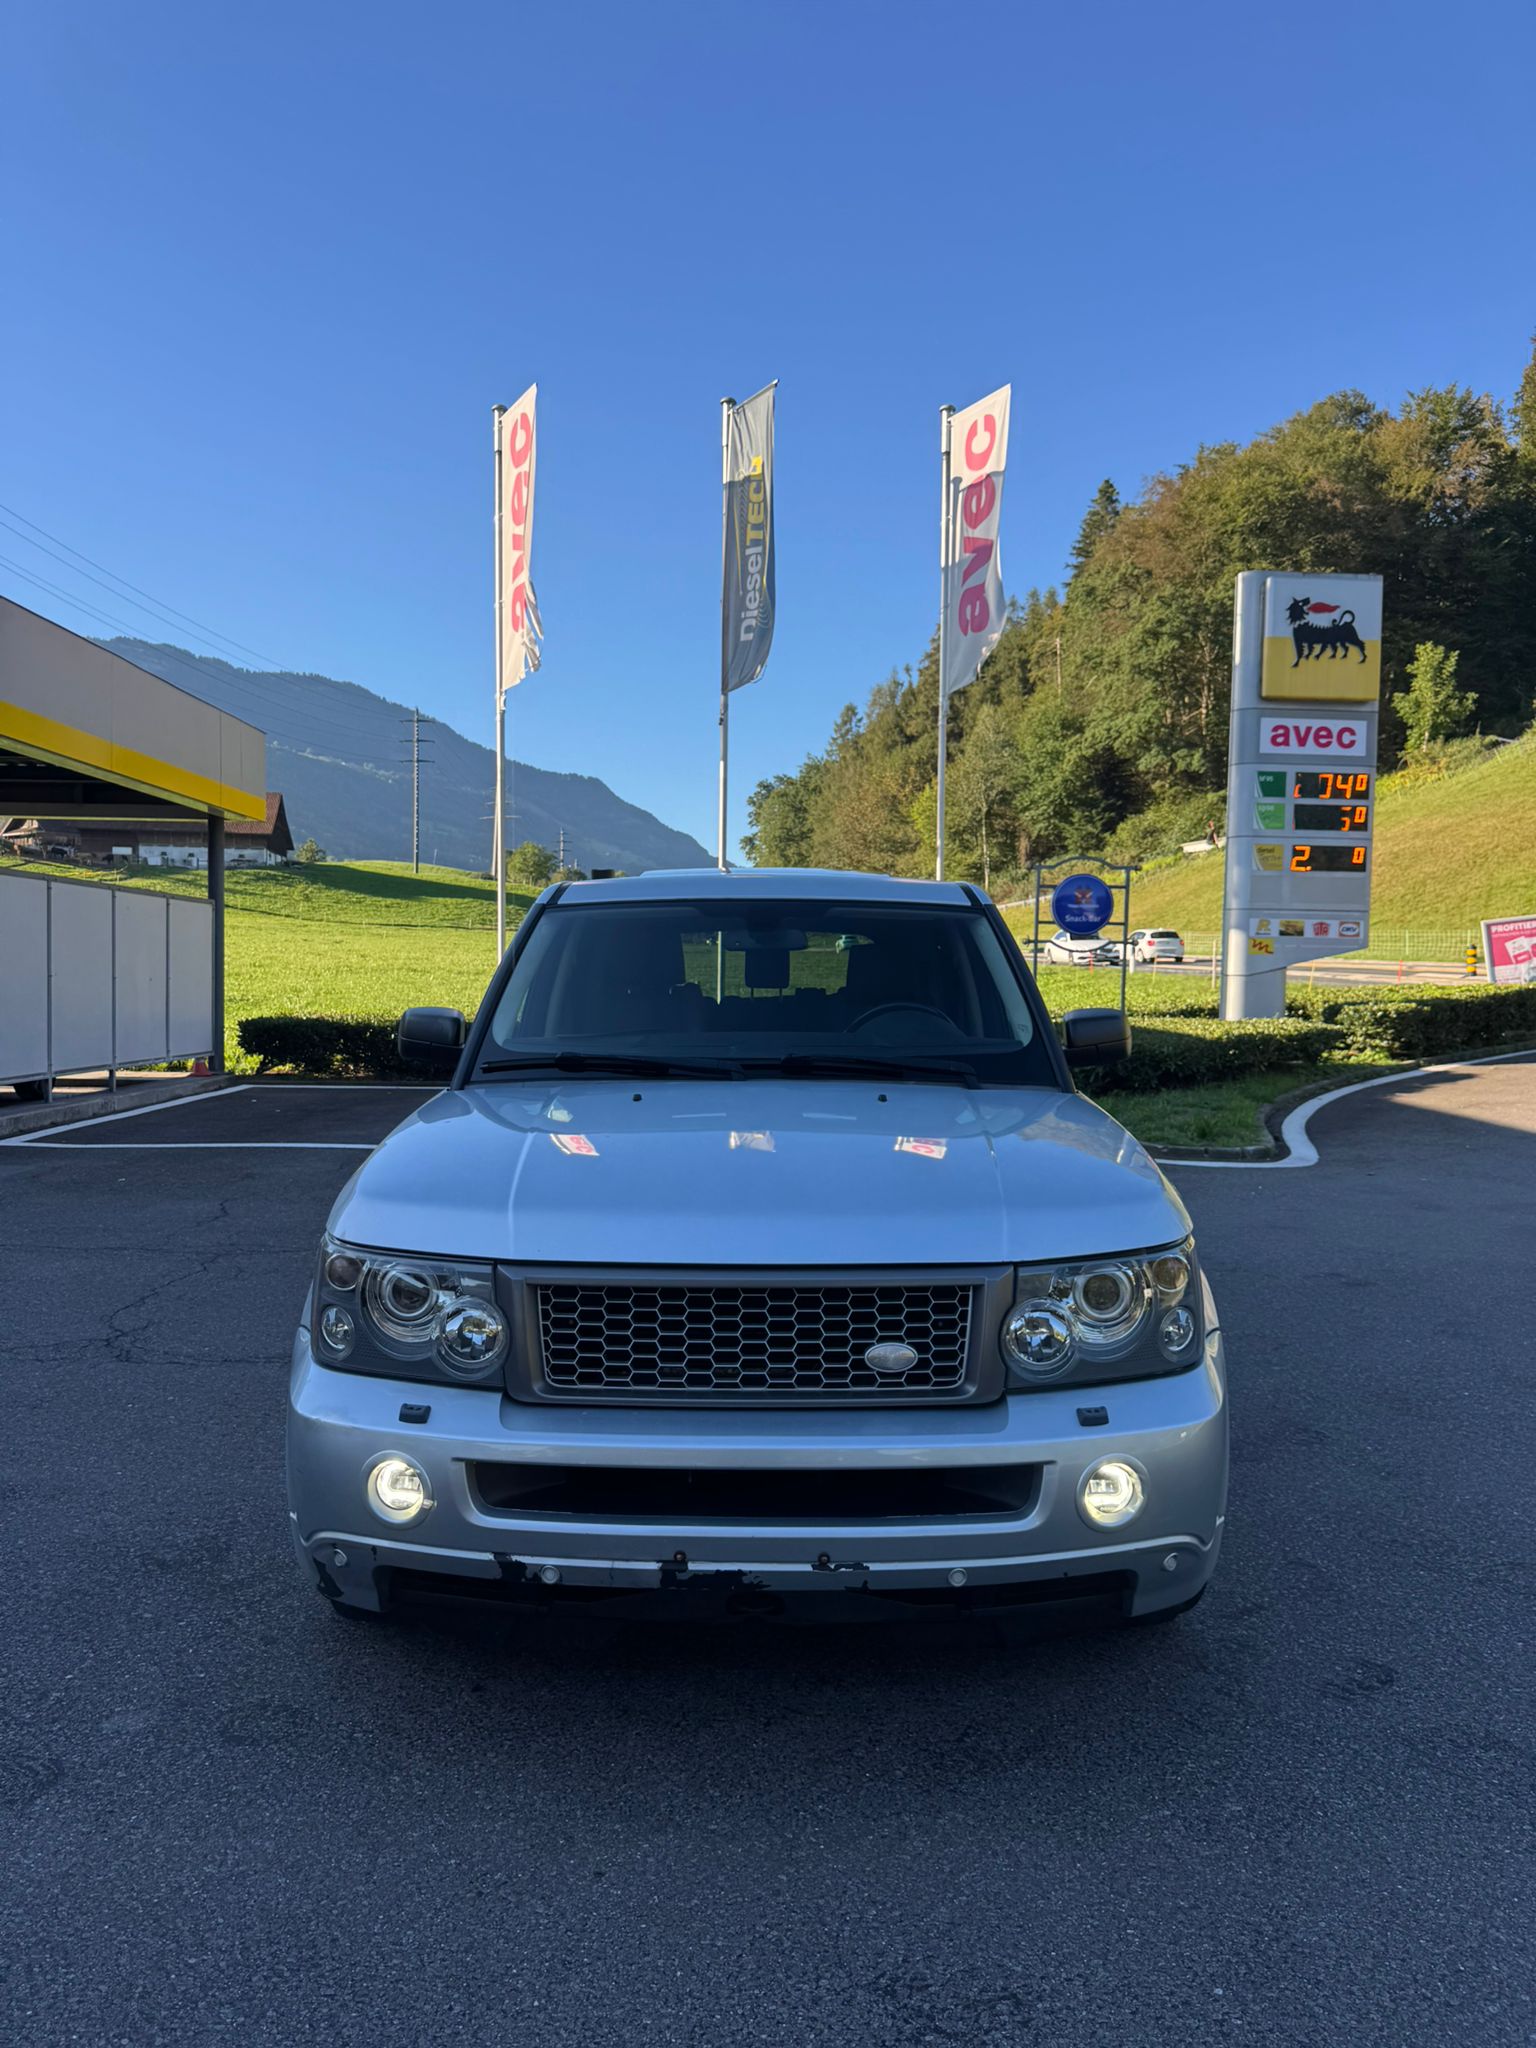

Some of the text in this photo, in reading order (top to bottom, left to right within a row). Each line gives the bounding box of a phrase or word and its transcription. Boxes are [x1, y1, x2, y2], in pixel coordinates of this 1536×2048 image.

[510, 412, 532, 633] avec
[958, 414, 996, 637] avec
[1270, 724, 1357, 749] avec
